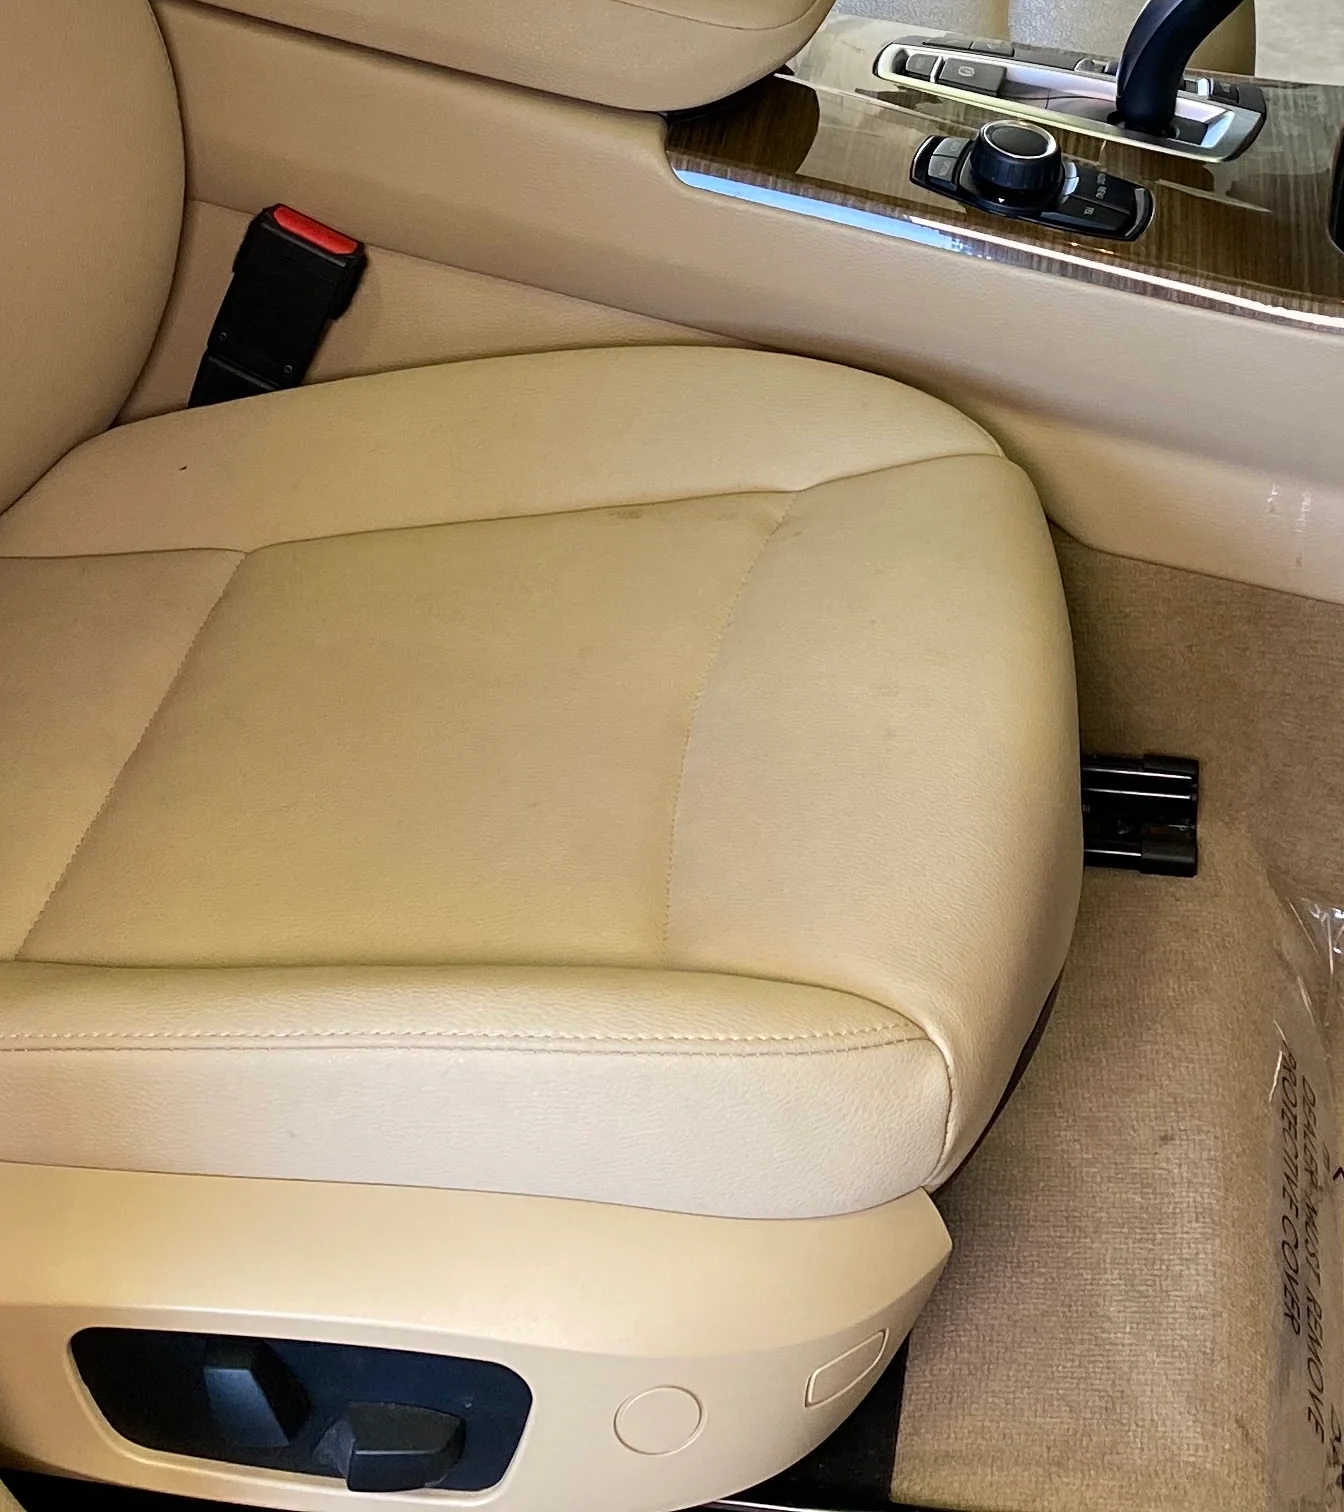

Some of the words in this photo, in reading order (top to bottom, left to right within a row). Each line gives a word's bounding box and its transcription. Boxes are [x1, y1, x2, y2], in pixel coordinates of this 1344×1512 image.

[1281, 1040, 1299, 1220] PROTECTIVE
[1282, 1215, 1301, 1336] COVER
[1306, 1286, 1325, 1445] REMOVE
